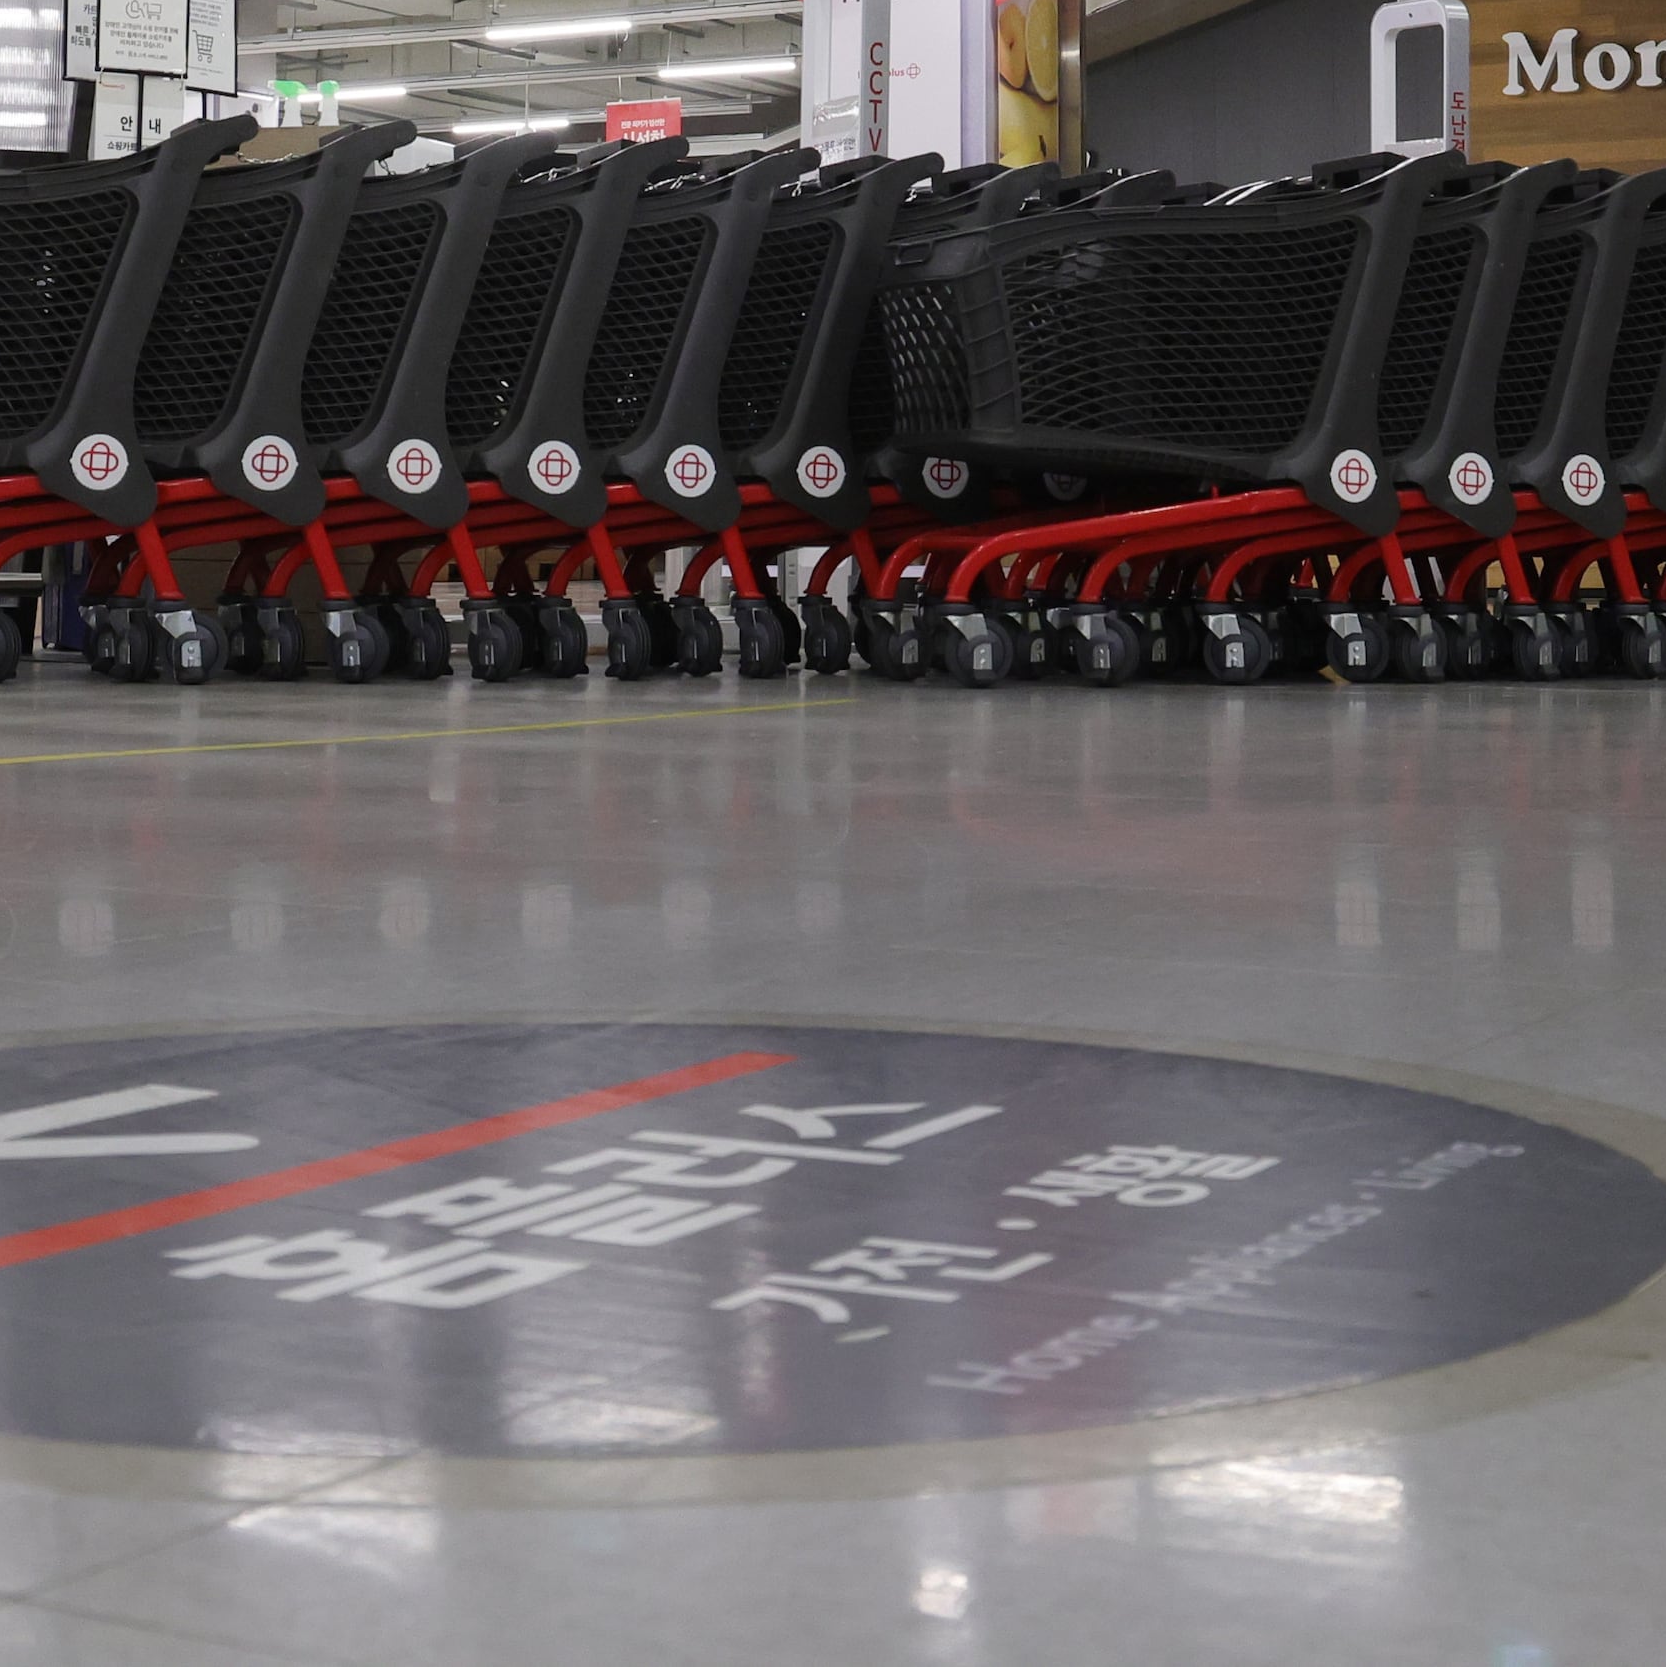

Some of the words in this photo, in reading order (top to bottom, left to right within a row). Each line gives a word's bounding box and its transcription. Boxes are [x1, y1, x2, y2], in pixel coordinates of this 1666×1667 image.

[869, 42, 883, 152] CCTV
[1451, 92, 1467, 152] 도난경
[163, 1102, 1005, 1309] 홈플러스
[926, 1314, 1161, 1395] Home
[1350, 1140, 1526, 1191] Living
